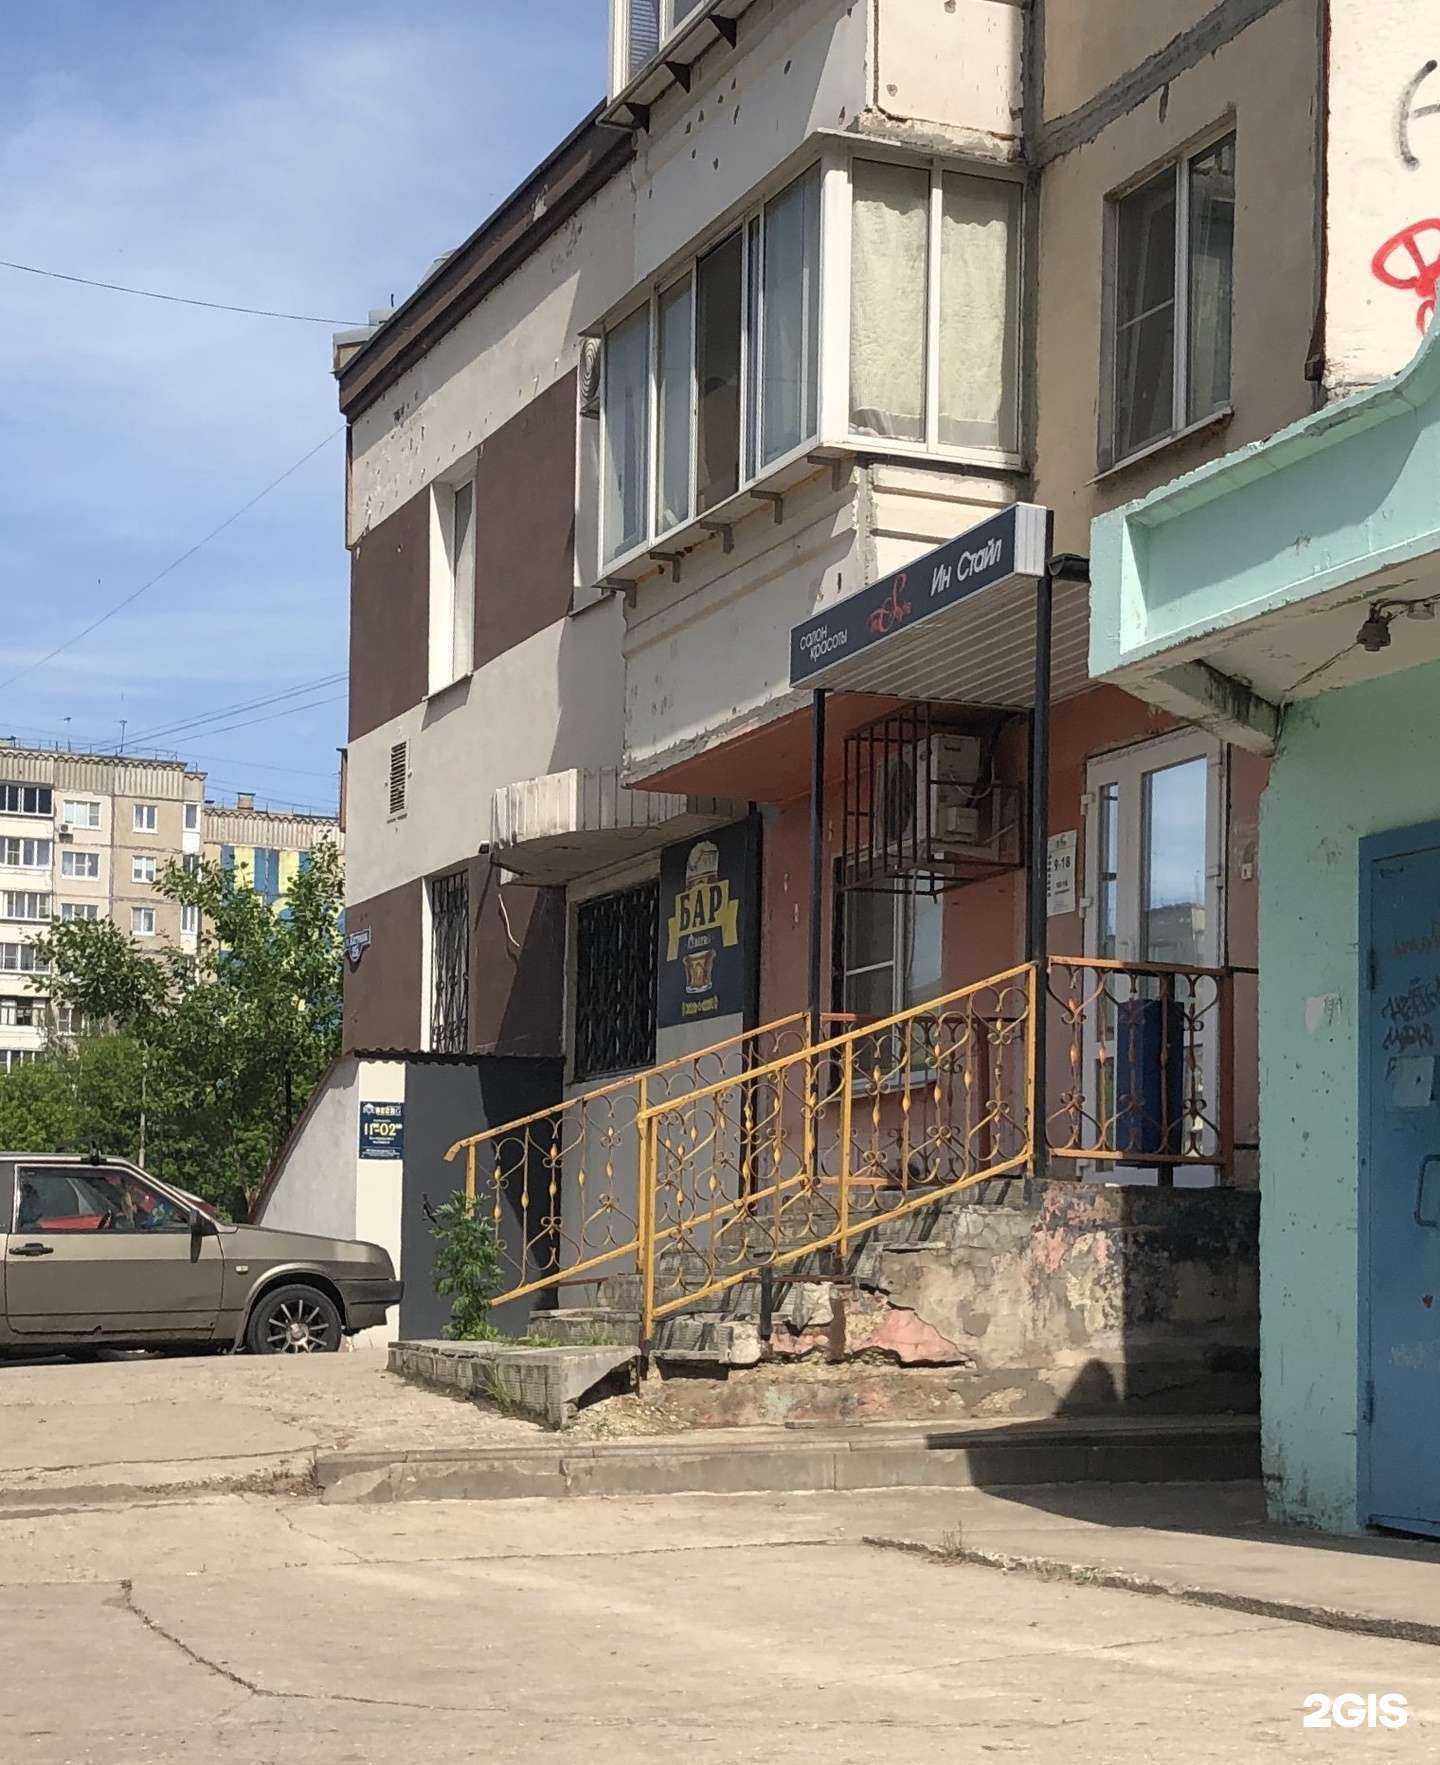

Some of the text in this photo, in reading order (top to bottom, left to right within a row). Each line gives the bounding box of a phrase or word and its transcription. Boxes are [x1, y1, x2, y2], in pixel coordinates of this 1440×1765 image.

[930, 538, 1002, 597] Ин Стайл
[799, 625, 828, 651] салон
[809, 630, 847, 662] красоты
[680, 885, 723, 930] БАР
